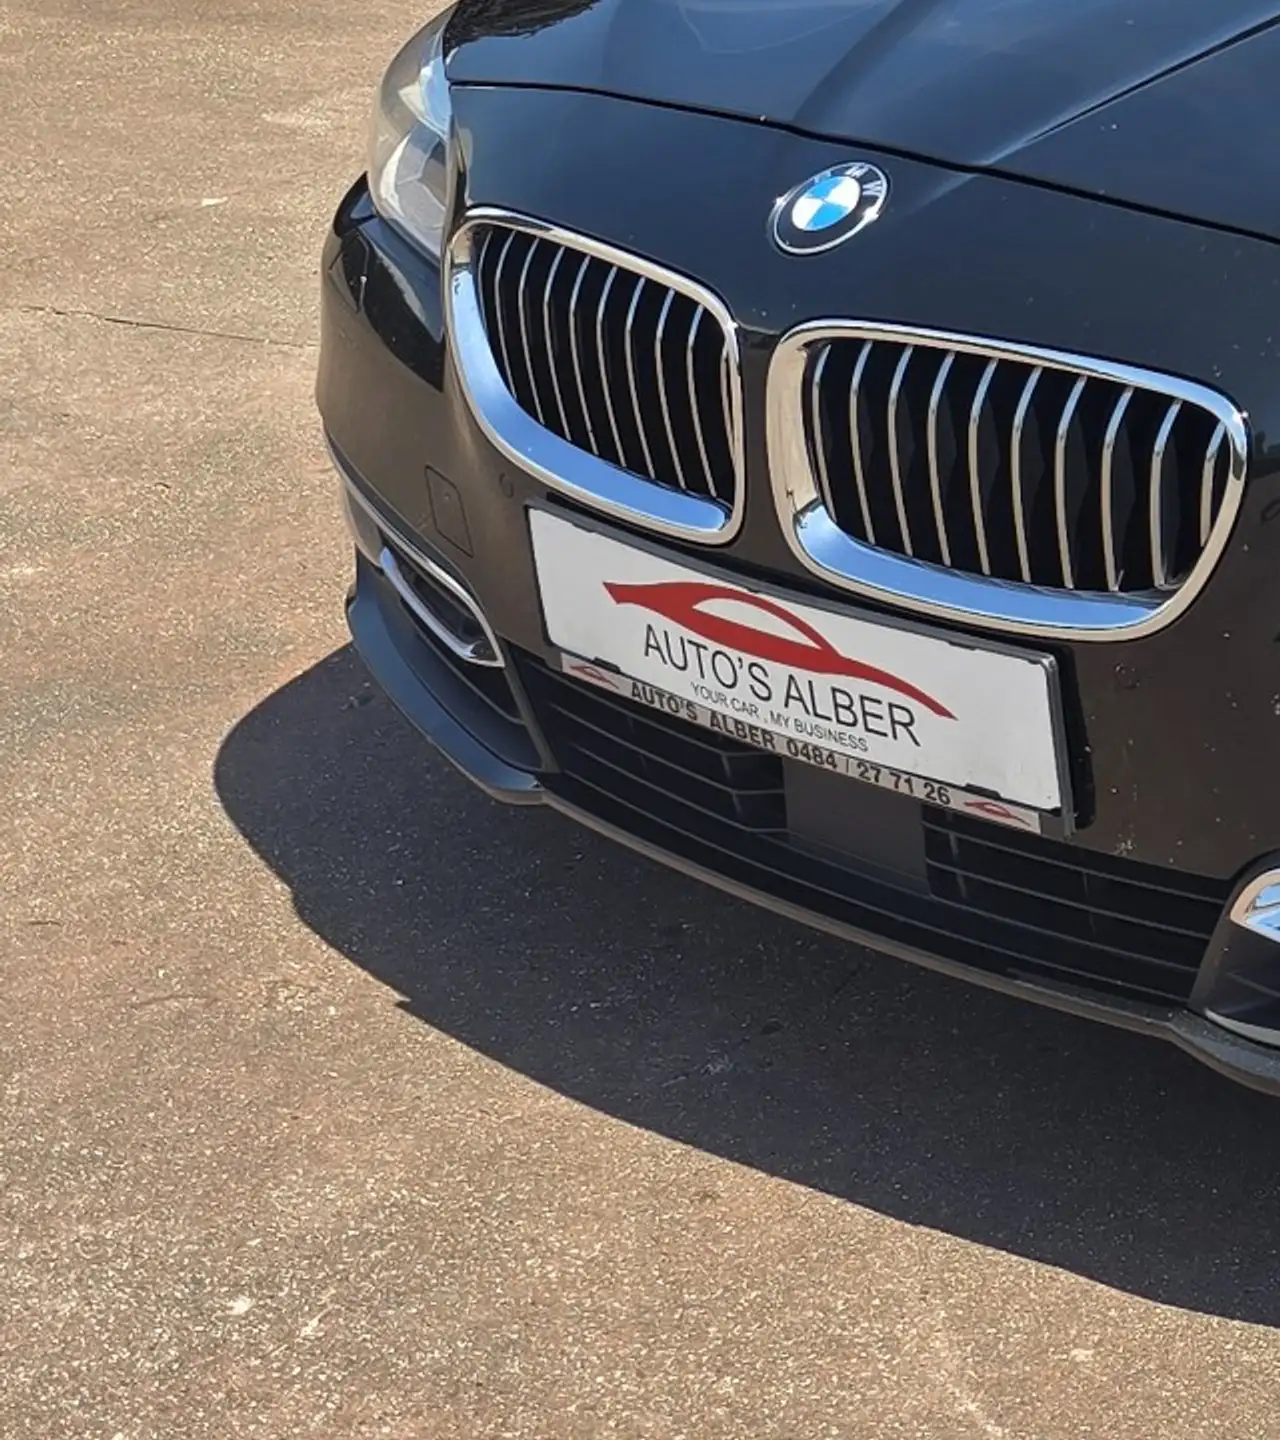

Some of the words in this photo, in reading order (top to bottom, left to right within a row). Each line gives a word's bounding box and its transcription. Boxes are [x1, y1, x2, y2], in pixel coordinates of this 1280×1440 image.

[631, 681, 699, 722] AUTO'S
[709, 710, 777, 751] ALBER
[786, 737, 839, 769] 0484
[857, 761, 882, 784] 27
[889, 771, 915, 794] 71
[923, 781, 952, 806] 26
[644, 623, 773, 702] AUTO'S
[784, 673, 922, 748] ALBER
[690, 681, 731, 709] YOUR
[731, 697, 761, 720] CAR
[769, 710, 791, 729] MY
[793, 717, 870, 753] BUSINESS
